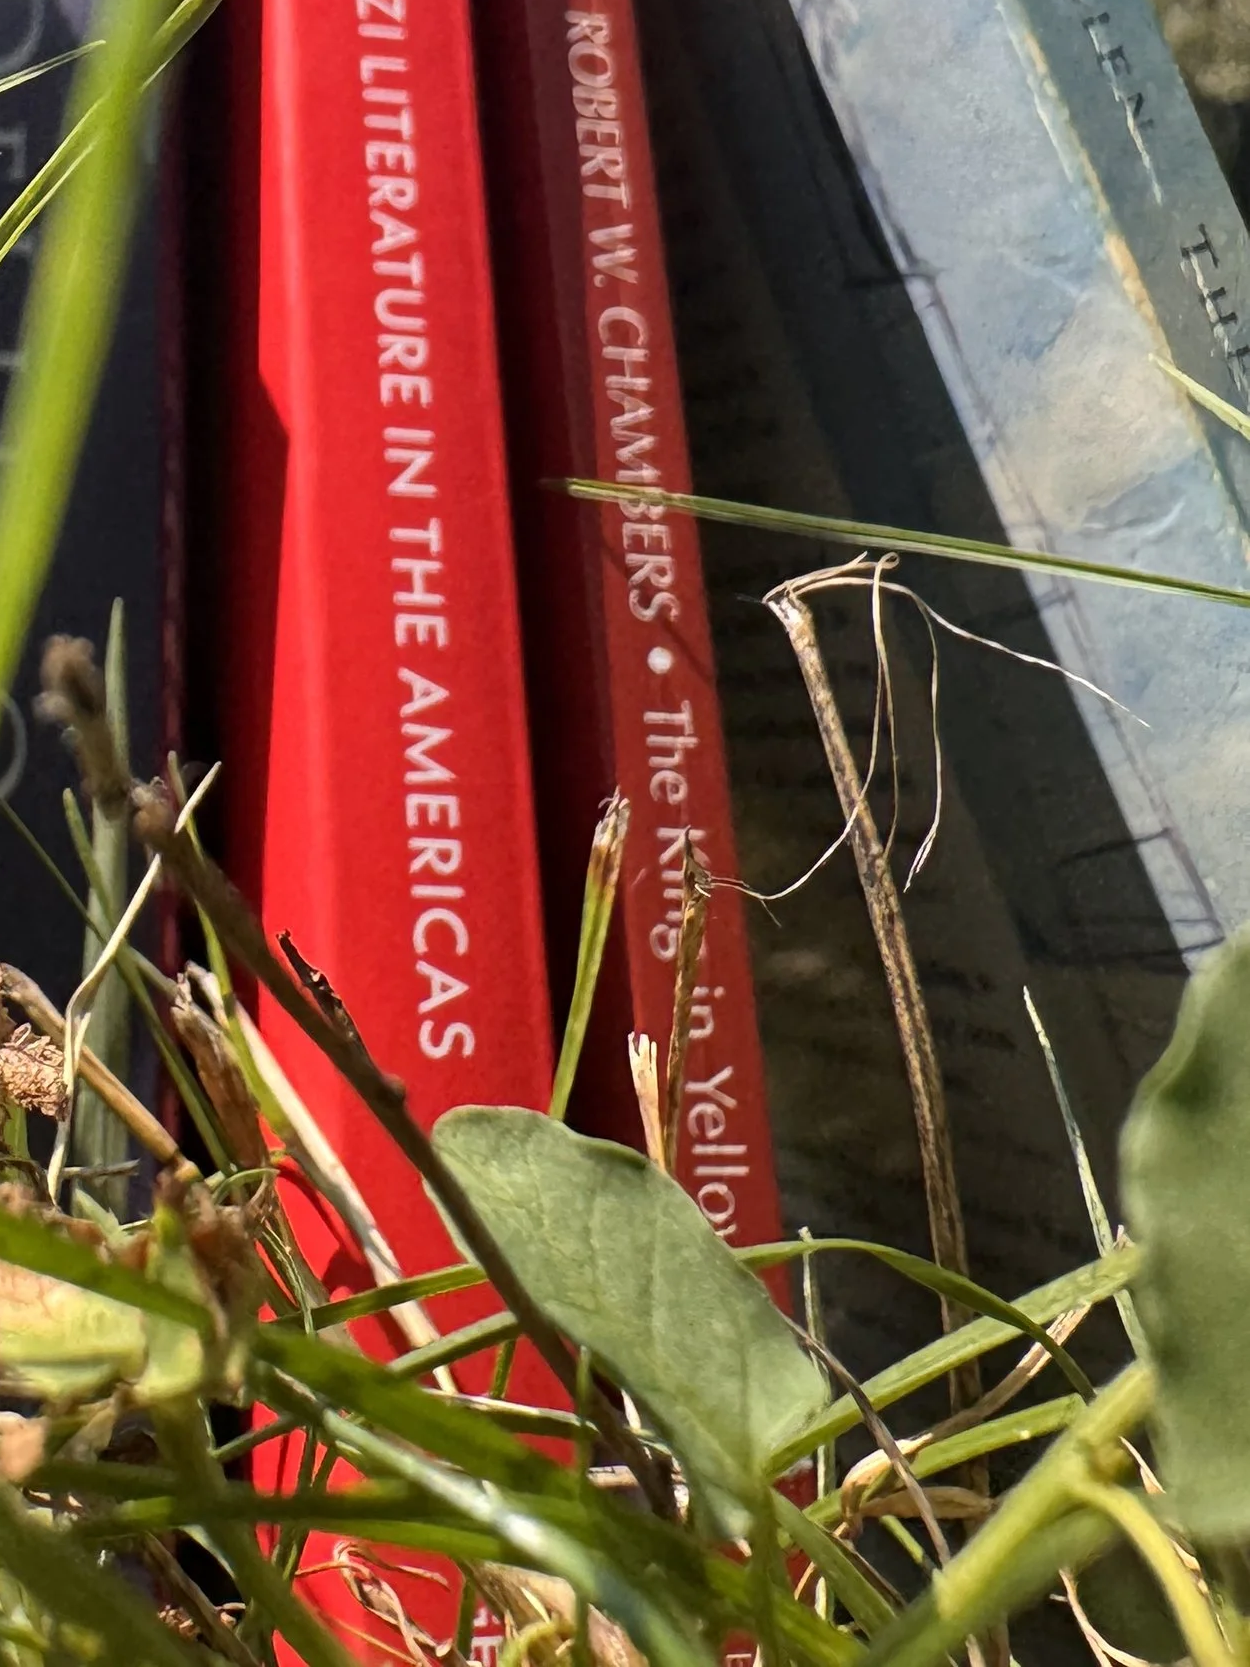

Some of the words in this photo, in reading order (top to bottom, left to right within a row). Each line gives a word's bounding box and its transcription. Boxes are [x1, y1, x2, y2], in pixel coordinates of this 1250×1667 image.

[565, 9, 630, 210] ROBERT
[359, 57, 432, 409] LITERATURE
[589, 223, 640, 289] W.
[382, 430, 437, 499] IN
[597, 305, 681, 625] CHAMBERS
[387, 518, 448, 650] THE
[643, 700, 700, 806] The
[396, 667, 476, 1060] AMERICAS
[688, 984, 726, 1039] in
[684, 1064, 750, 1238] Yello
